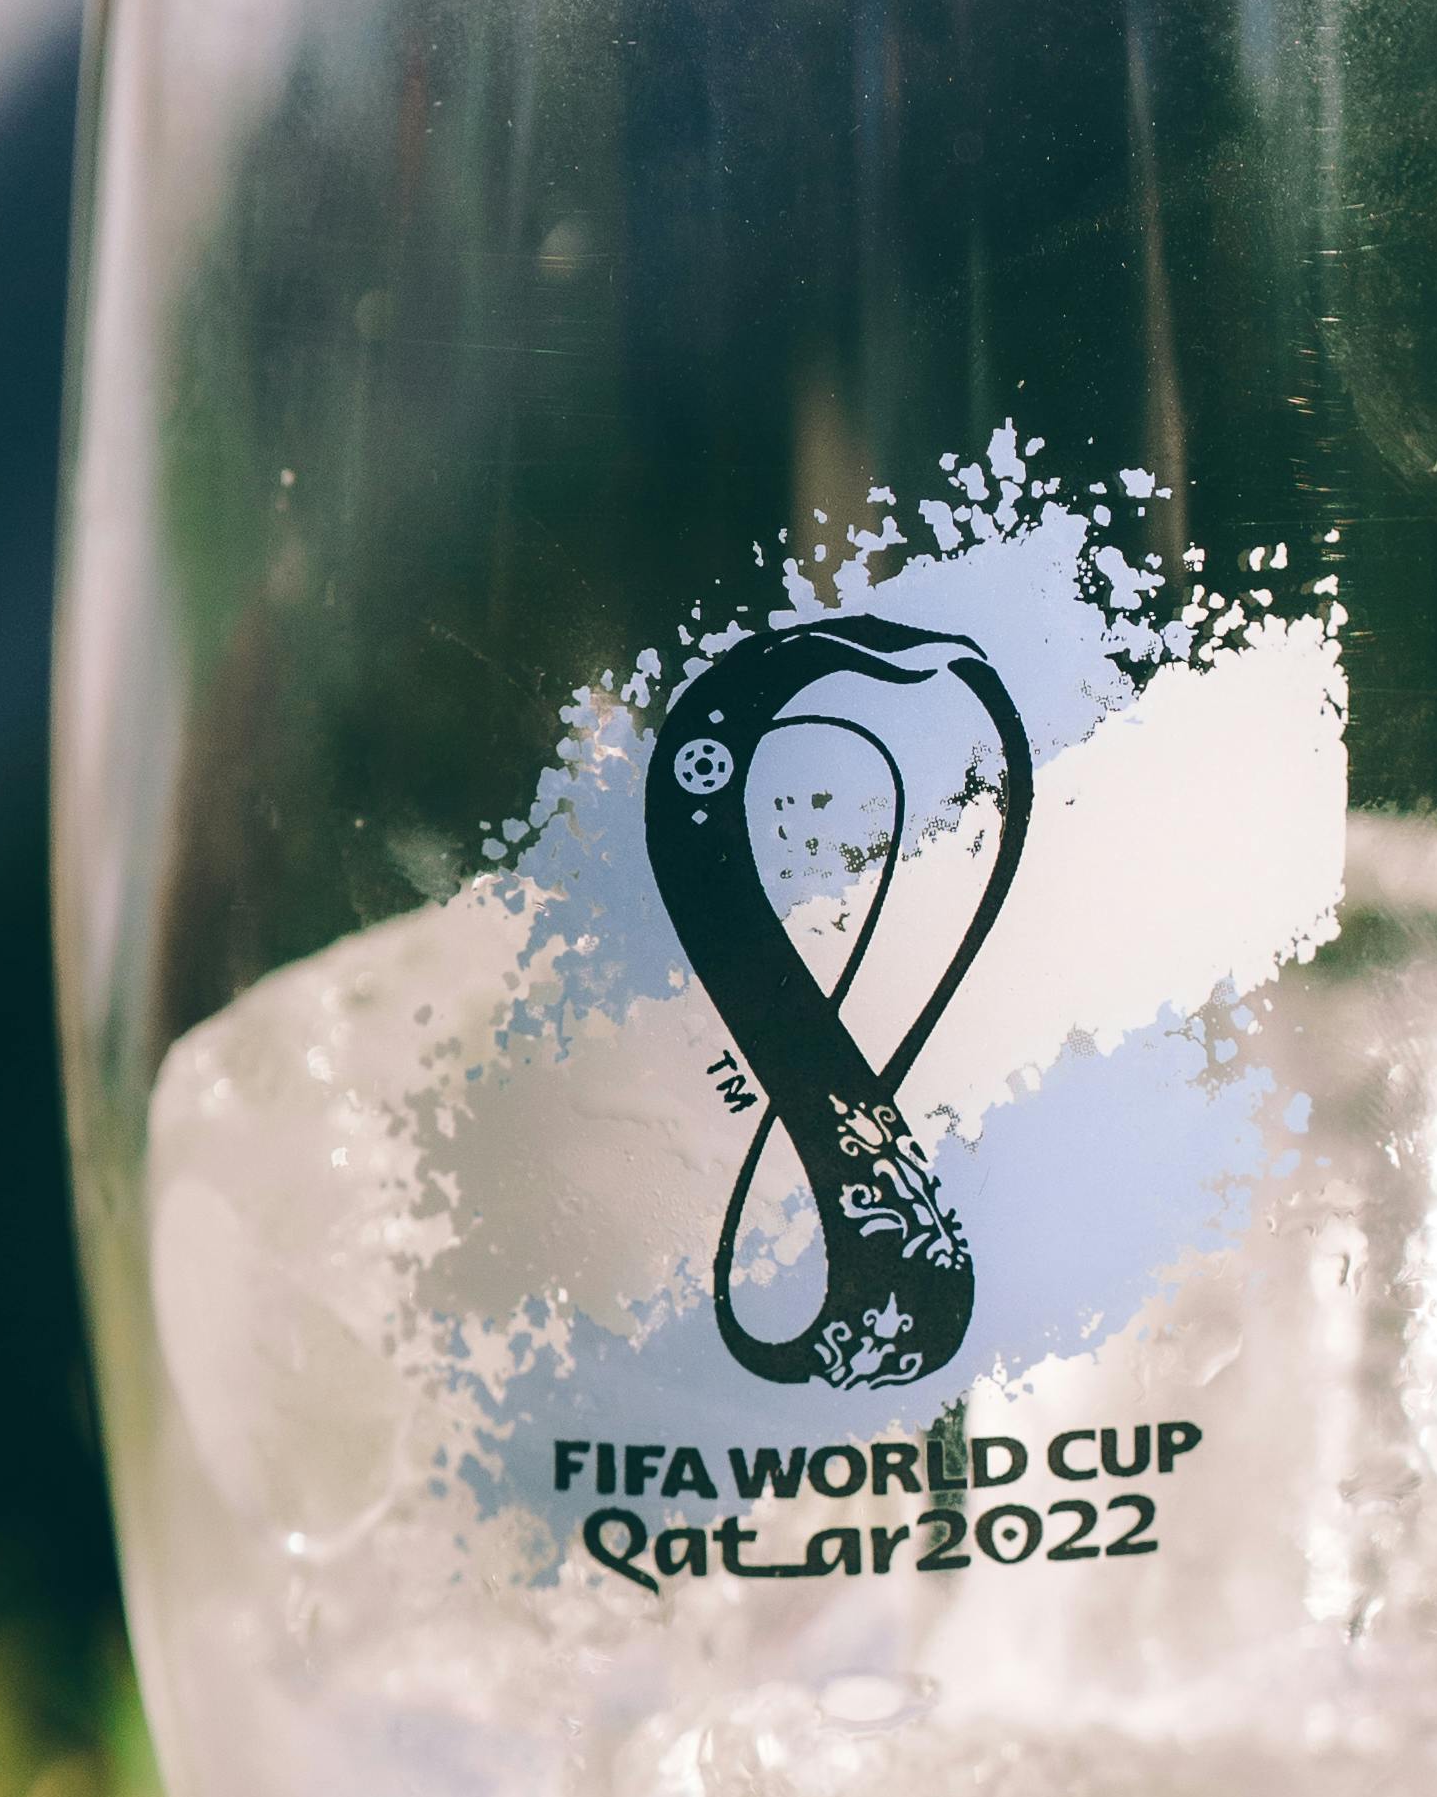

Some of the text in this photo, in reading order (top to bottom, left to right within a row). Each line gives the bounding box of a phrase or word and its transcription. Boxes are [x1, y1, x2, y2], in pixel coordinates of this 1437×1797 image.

[706, 1049, 758, 1114] TM
[553, 1420, 1203, 1499] FIFA WORLD CUP
